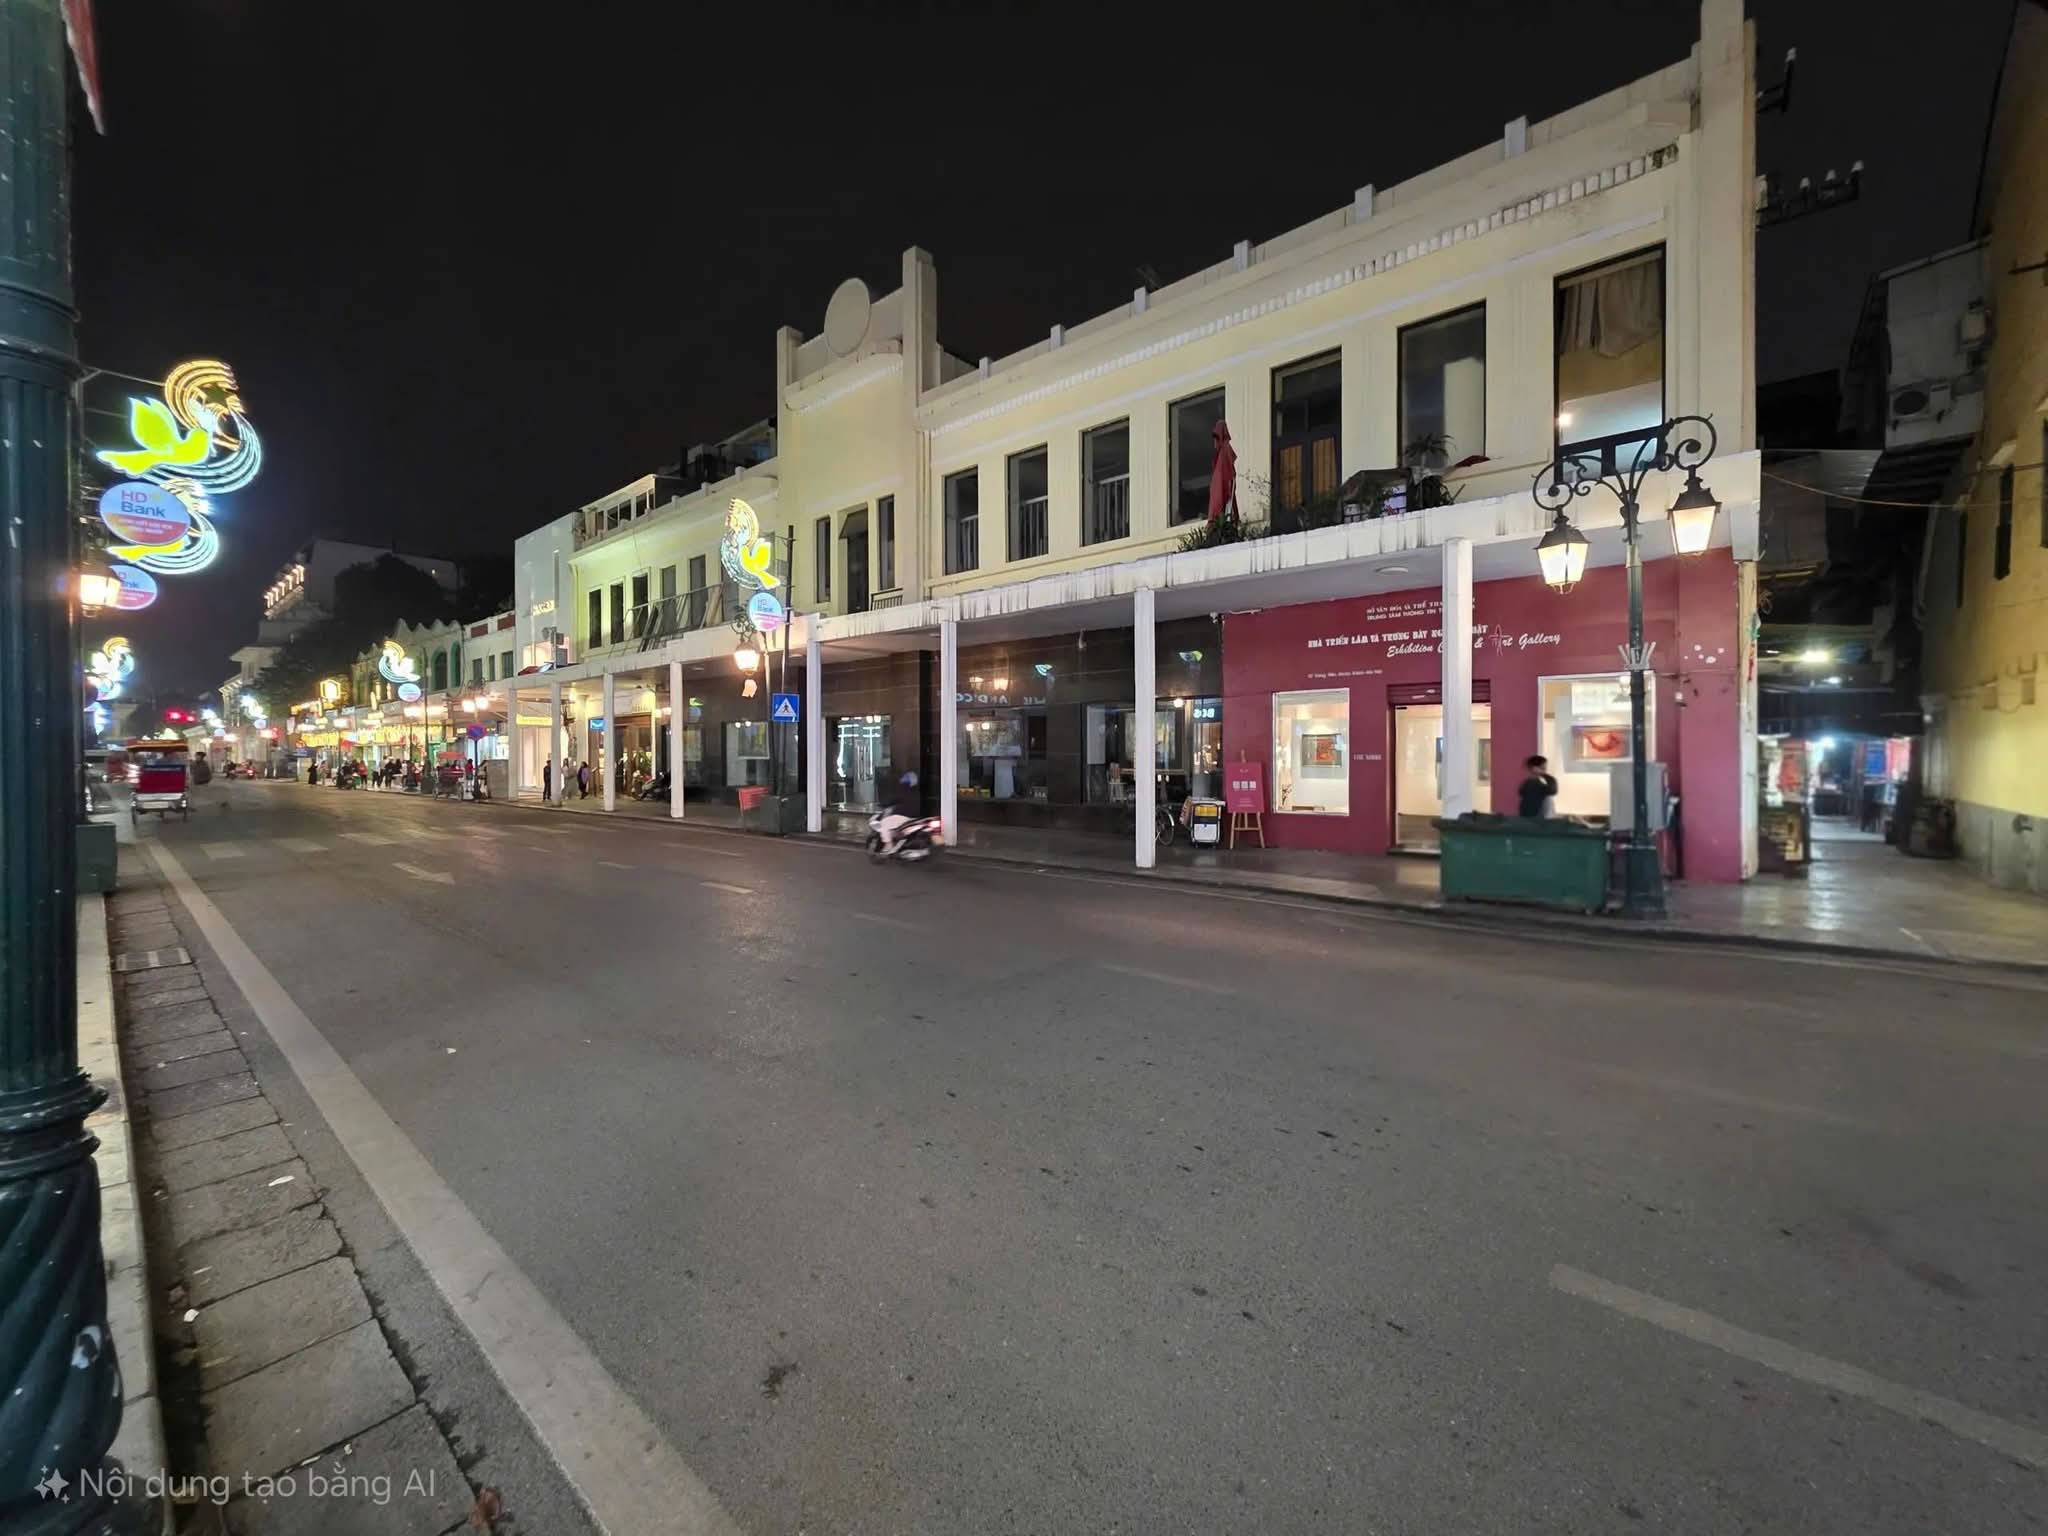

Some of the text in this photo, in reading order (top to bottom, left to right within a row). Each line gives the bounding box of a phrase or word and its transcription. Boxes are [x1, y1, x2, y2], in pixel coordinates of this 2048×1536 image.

[121, 490, 147, 503] HD
[121, 501, 166, 518] Bank
[1308, 637, 1322, 648] NHÀ
[1325, 634, 1349, 647] TRIỂN
[1370, 632, 1379, 643] VÀ
[1386, 641, 1433, 658] Exhibition
[1474, 637, 1485, 649] &
[1518, 633, 1561, 650] Gallery
